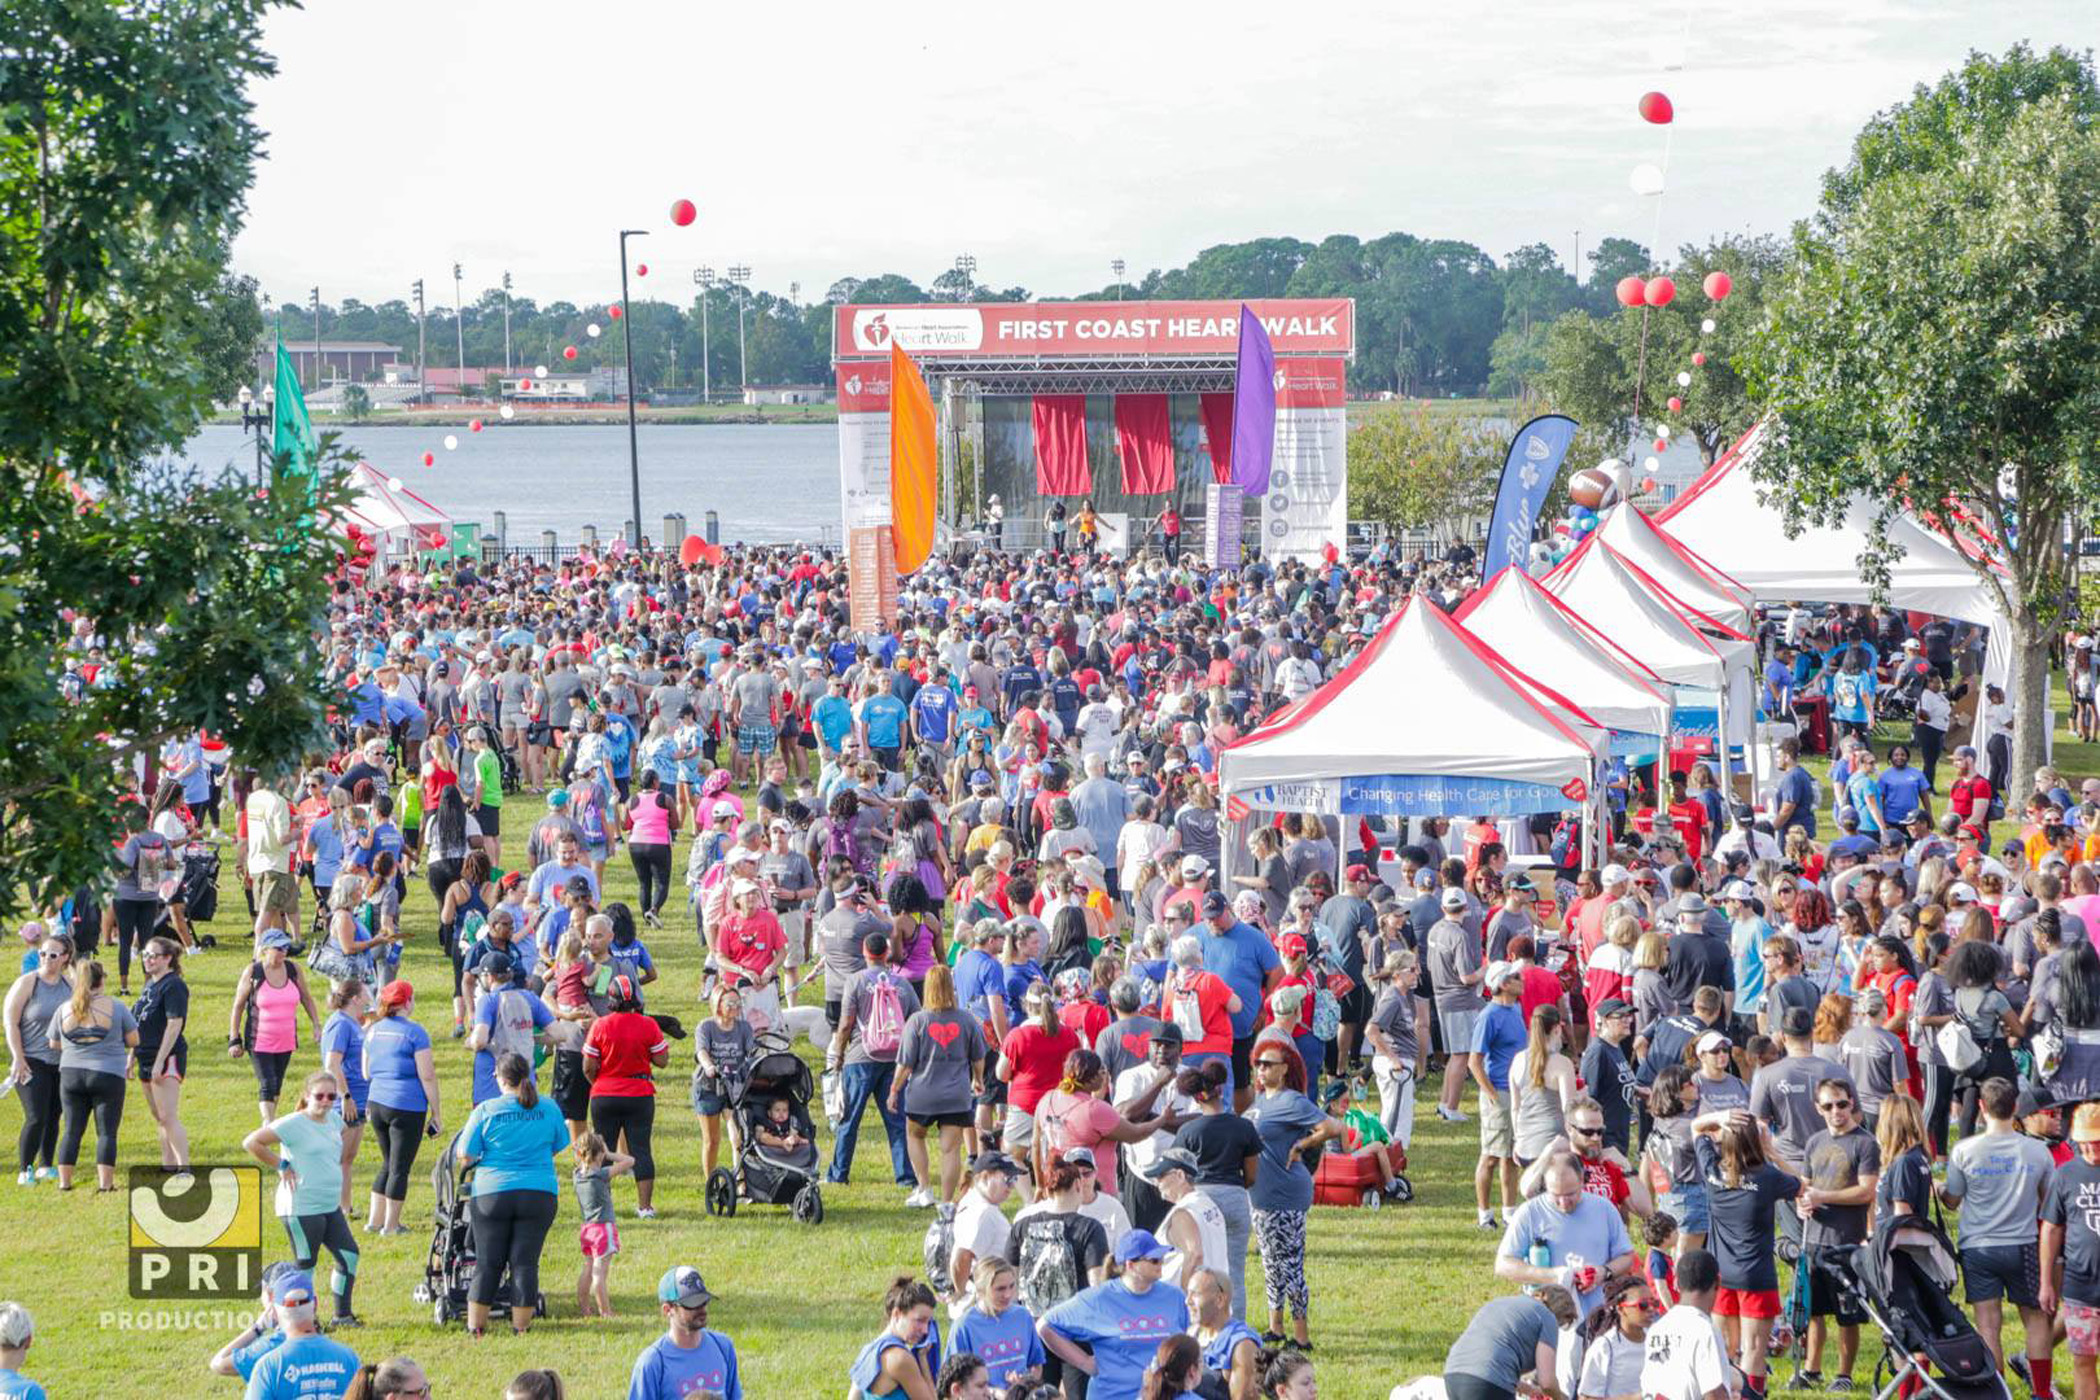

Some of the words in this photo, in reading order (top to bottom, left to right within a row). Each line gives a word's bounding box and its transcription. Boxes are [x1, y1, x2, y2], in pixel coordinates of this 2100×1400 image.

[999, 320, 1068, 339] FIRST
[1075, 319, 1161, 338] COAST
[1168, 318, 1241, 337] HEAR
[1259, 316, 1337, 336] WALK
[1671, 720, 1719, 737] lorida
[1278, 784, 1327, 798] BAPTIST
[1348, 786, 1414, 805] Changing
[1418, 787, 1463, 802] Health
[1466, 786, 1501, 801] Care
[1504, 784, 1525, 800] for
[1528, 784, 1560, 799] Goo
